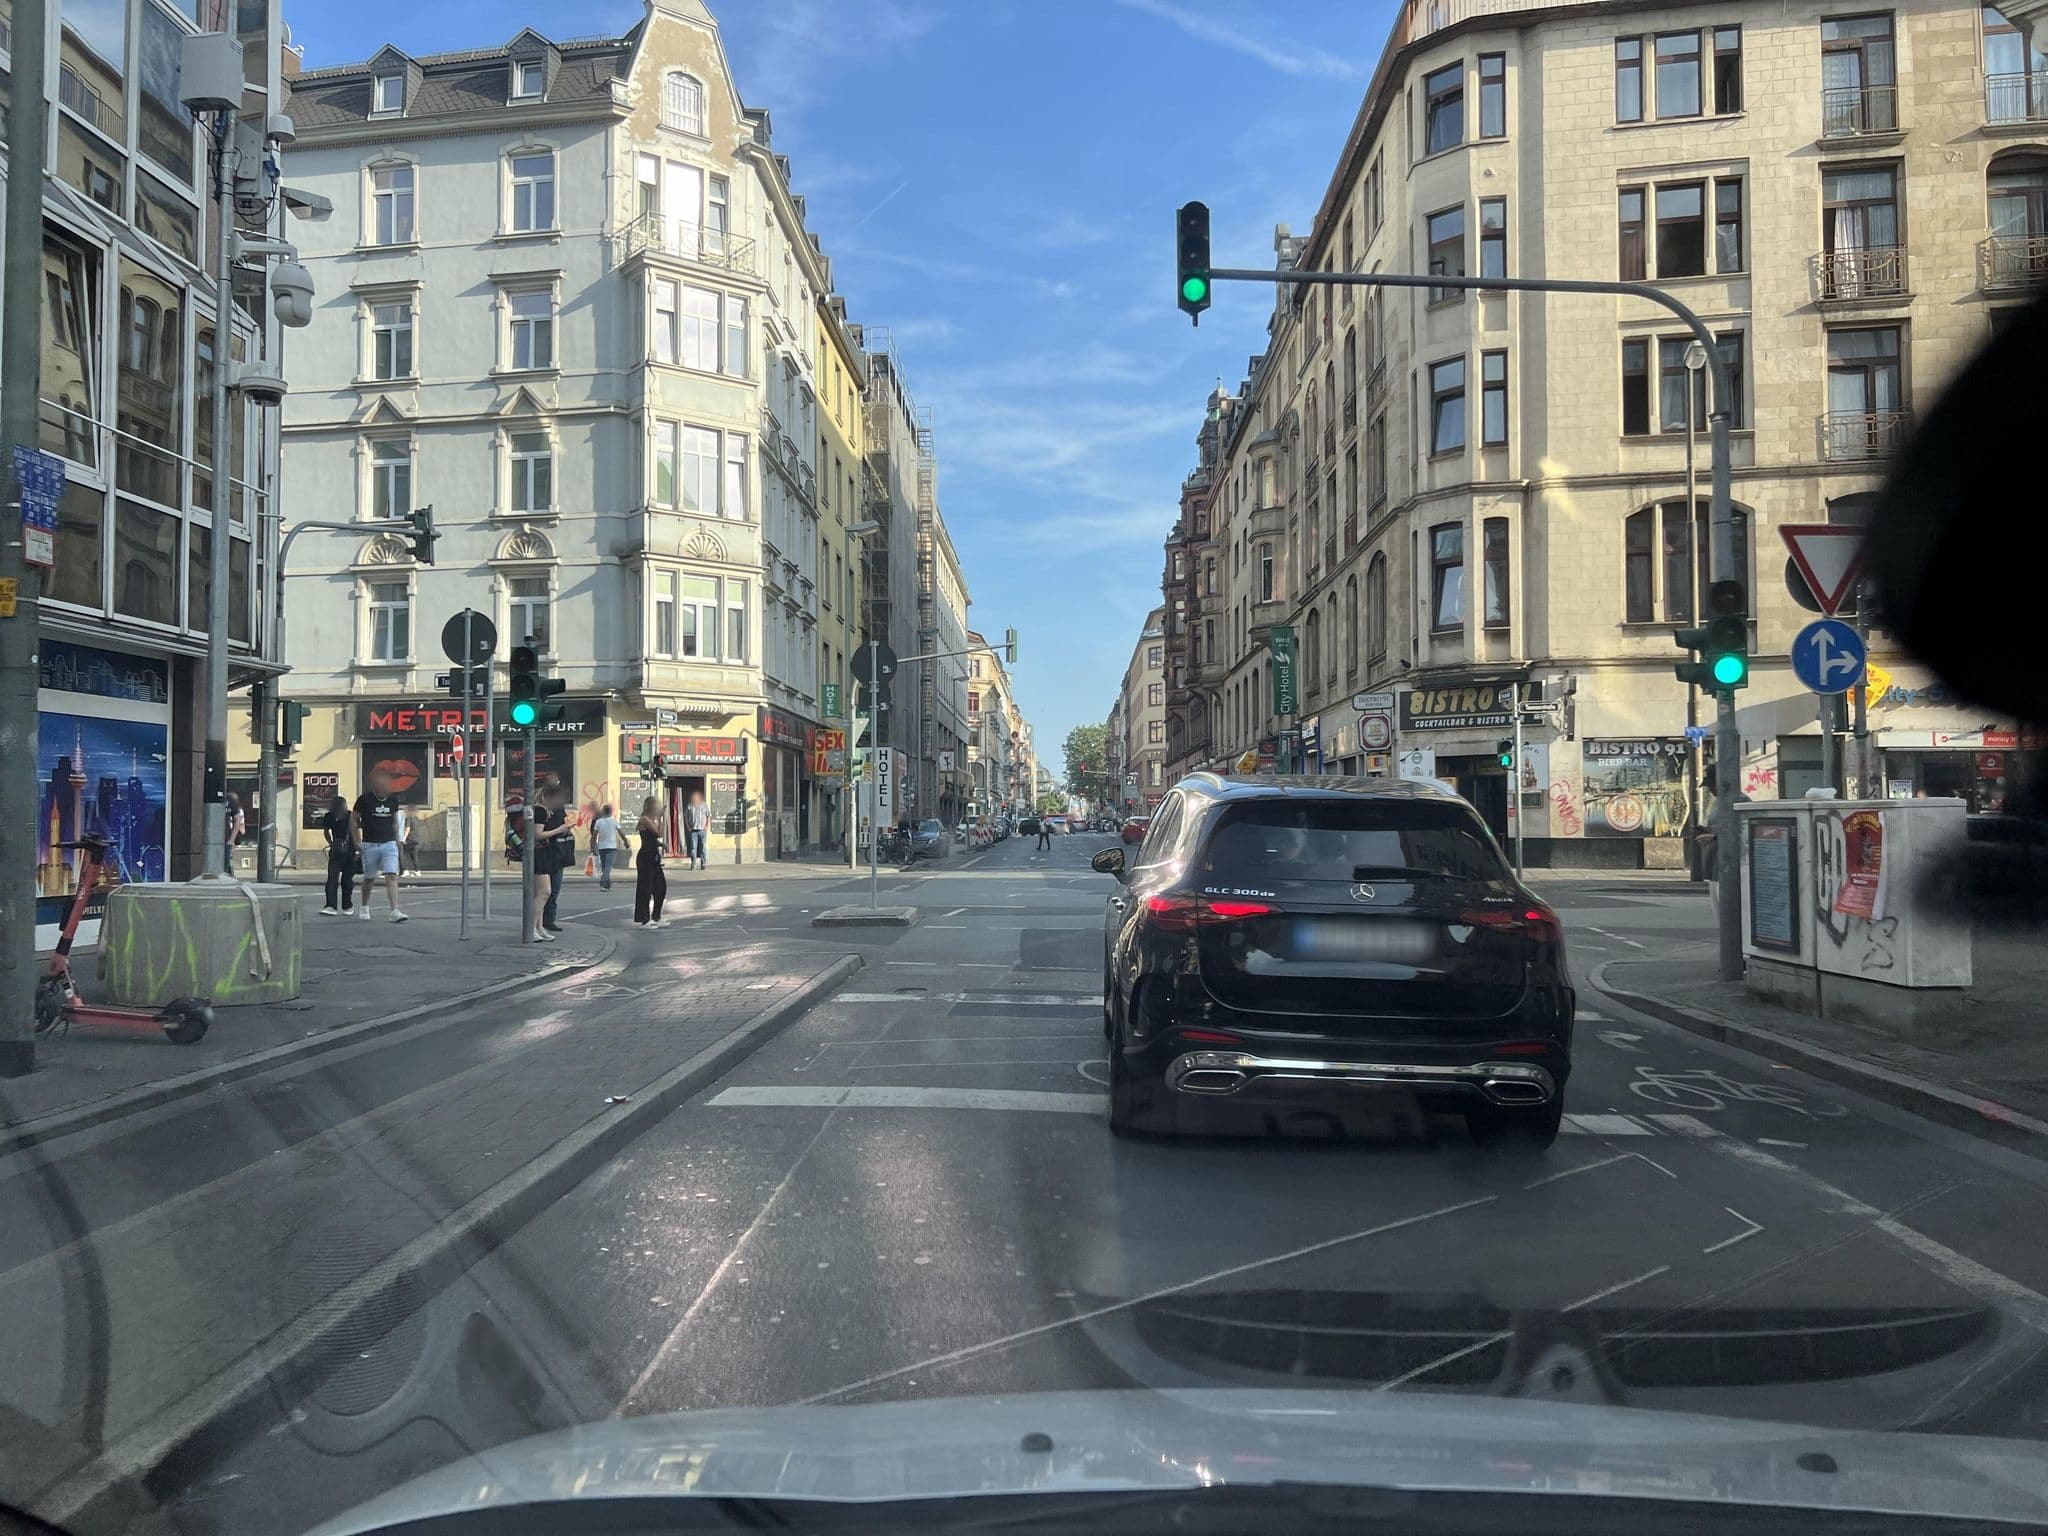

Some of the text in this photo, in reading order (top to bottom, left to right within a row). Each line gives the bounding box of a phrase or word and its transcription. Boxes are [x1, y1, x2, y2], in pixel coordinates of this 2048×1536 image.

[1280, 666, 1292, 714] City Hotel
[826, 686, 835, 716] HOTEL
[1410, 687, 1494, 715] BISTRO
[1415, 719, 1465, 728] COCKTAILBAR
[1477, 715, 1505, 725] BISTRO
[1509, 715, 1525, 724] BR
[437, 724, 486, 733] CENTE
[816, 731, 844, 752] SEX
[1589, 742, 1686, 756] BISTRO 91
[695, 755, 744, 763] FRANKFURT
[1598, 758, 1648, 767] BIER BAR
[304, 775, 338, 786] 1000
[878, 750, 888, 806] HOTEL
[1204, 886, 1230, 894] GLC
